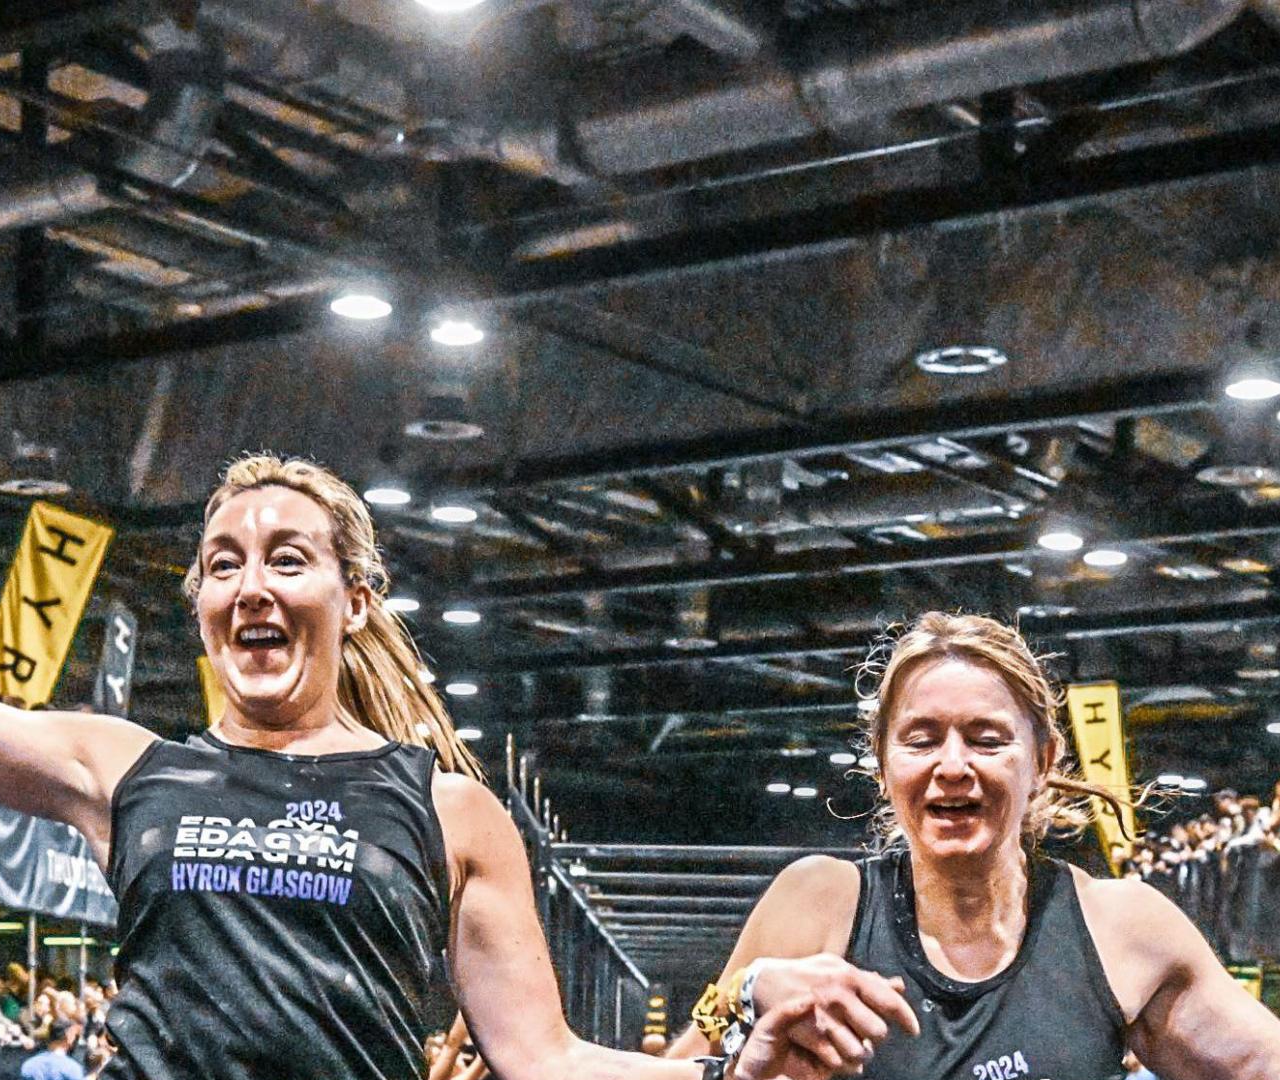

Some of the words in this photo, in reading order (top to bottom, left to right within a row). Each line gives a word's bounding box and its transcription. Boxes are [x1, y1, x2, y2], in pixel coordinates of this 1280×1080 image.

[285, 800, 344, 822] 2024
[175, 827, 257, 849] EDA
[264, 831, 359, 860] GYM
[171, 862, 240, 893] HYROX
[246, 865, 353, 906] GLASGOW
